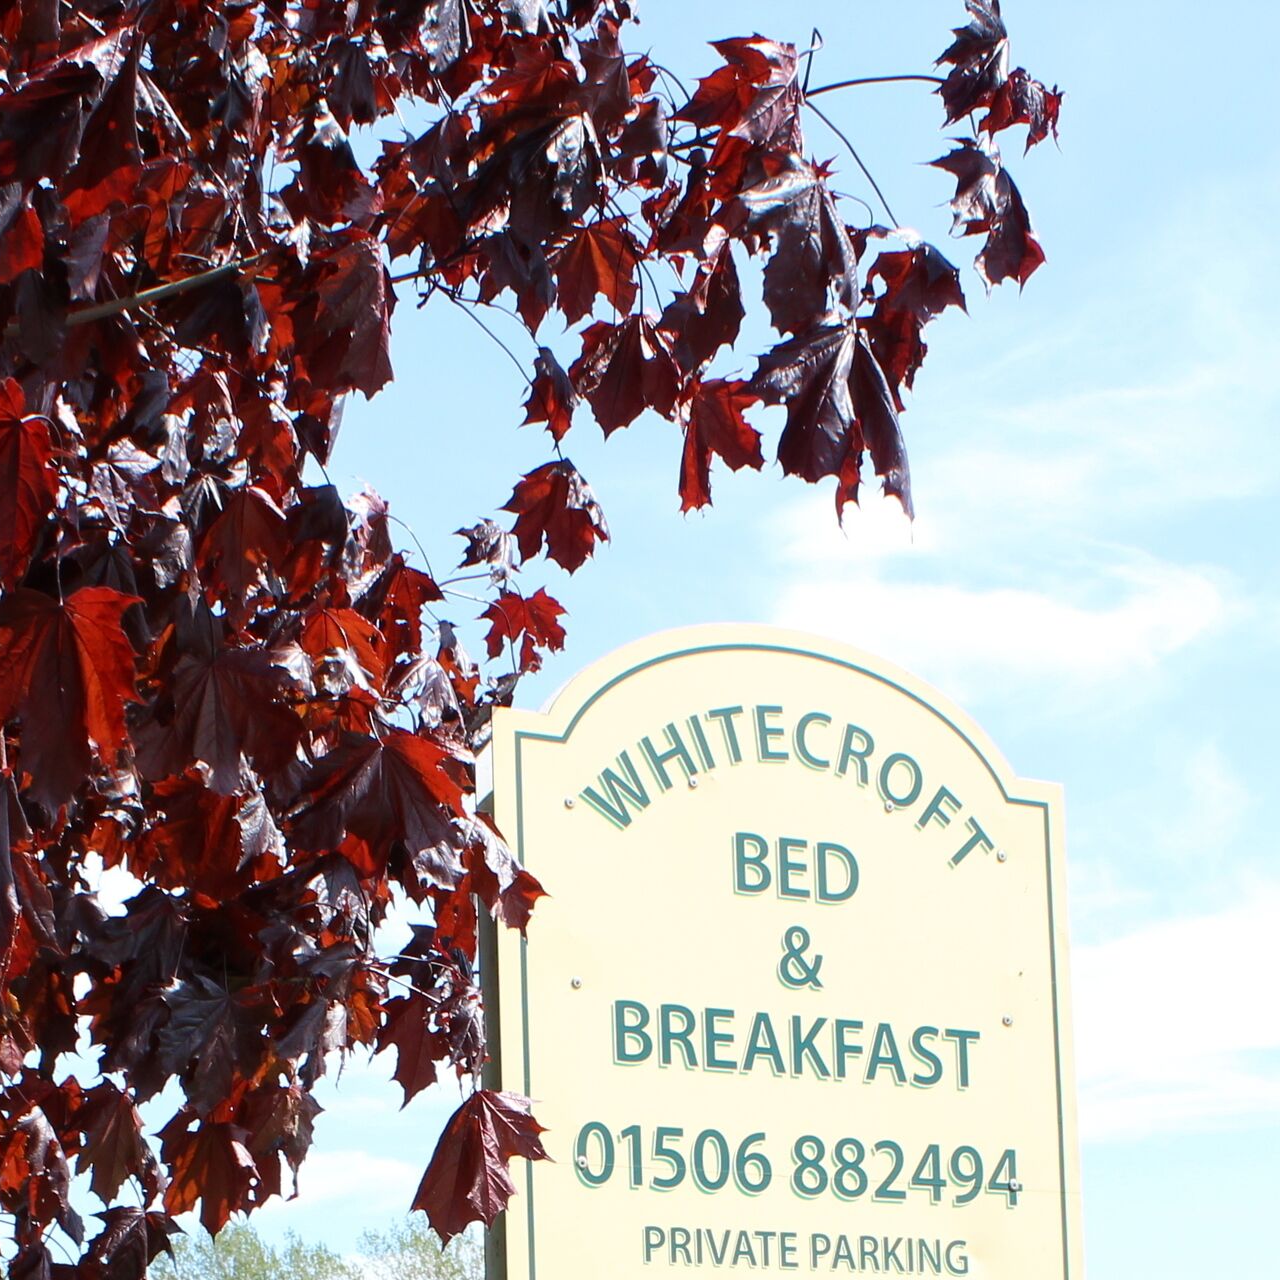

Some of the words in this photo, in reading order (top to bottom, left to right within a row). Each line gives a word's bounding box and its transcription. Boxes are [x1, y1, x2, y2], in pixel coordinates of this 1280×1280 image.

[580, 704, 995, 868] WHITECROFT
[733, 832, 860, 903] BED
[778, 925, 823, 989] &
[612, 1000, 981, 1090] BREAKFAST
[574, 1121, 772, 1193] 01506
[792, 1135, 1024, 1207] 882494
[643, 1226, 799, 1268] PRIVATE
[810, 1233, 970, 1275] PARKING
